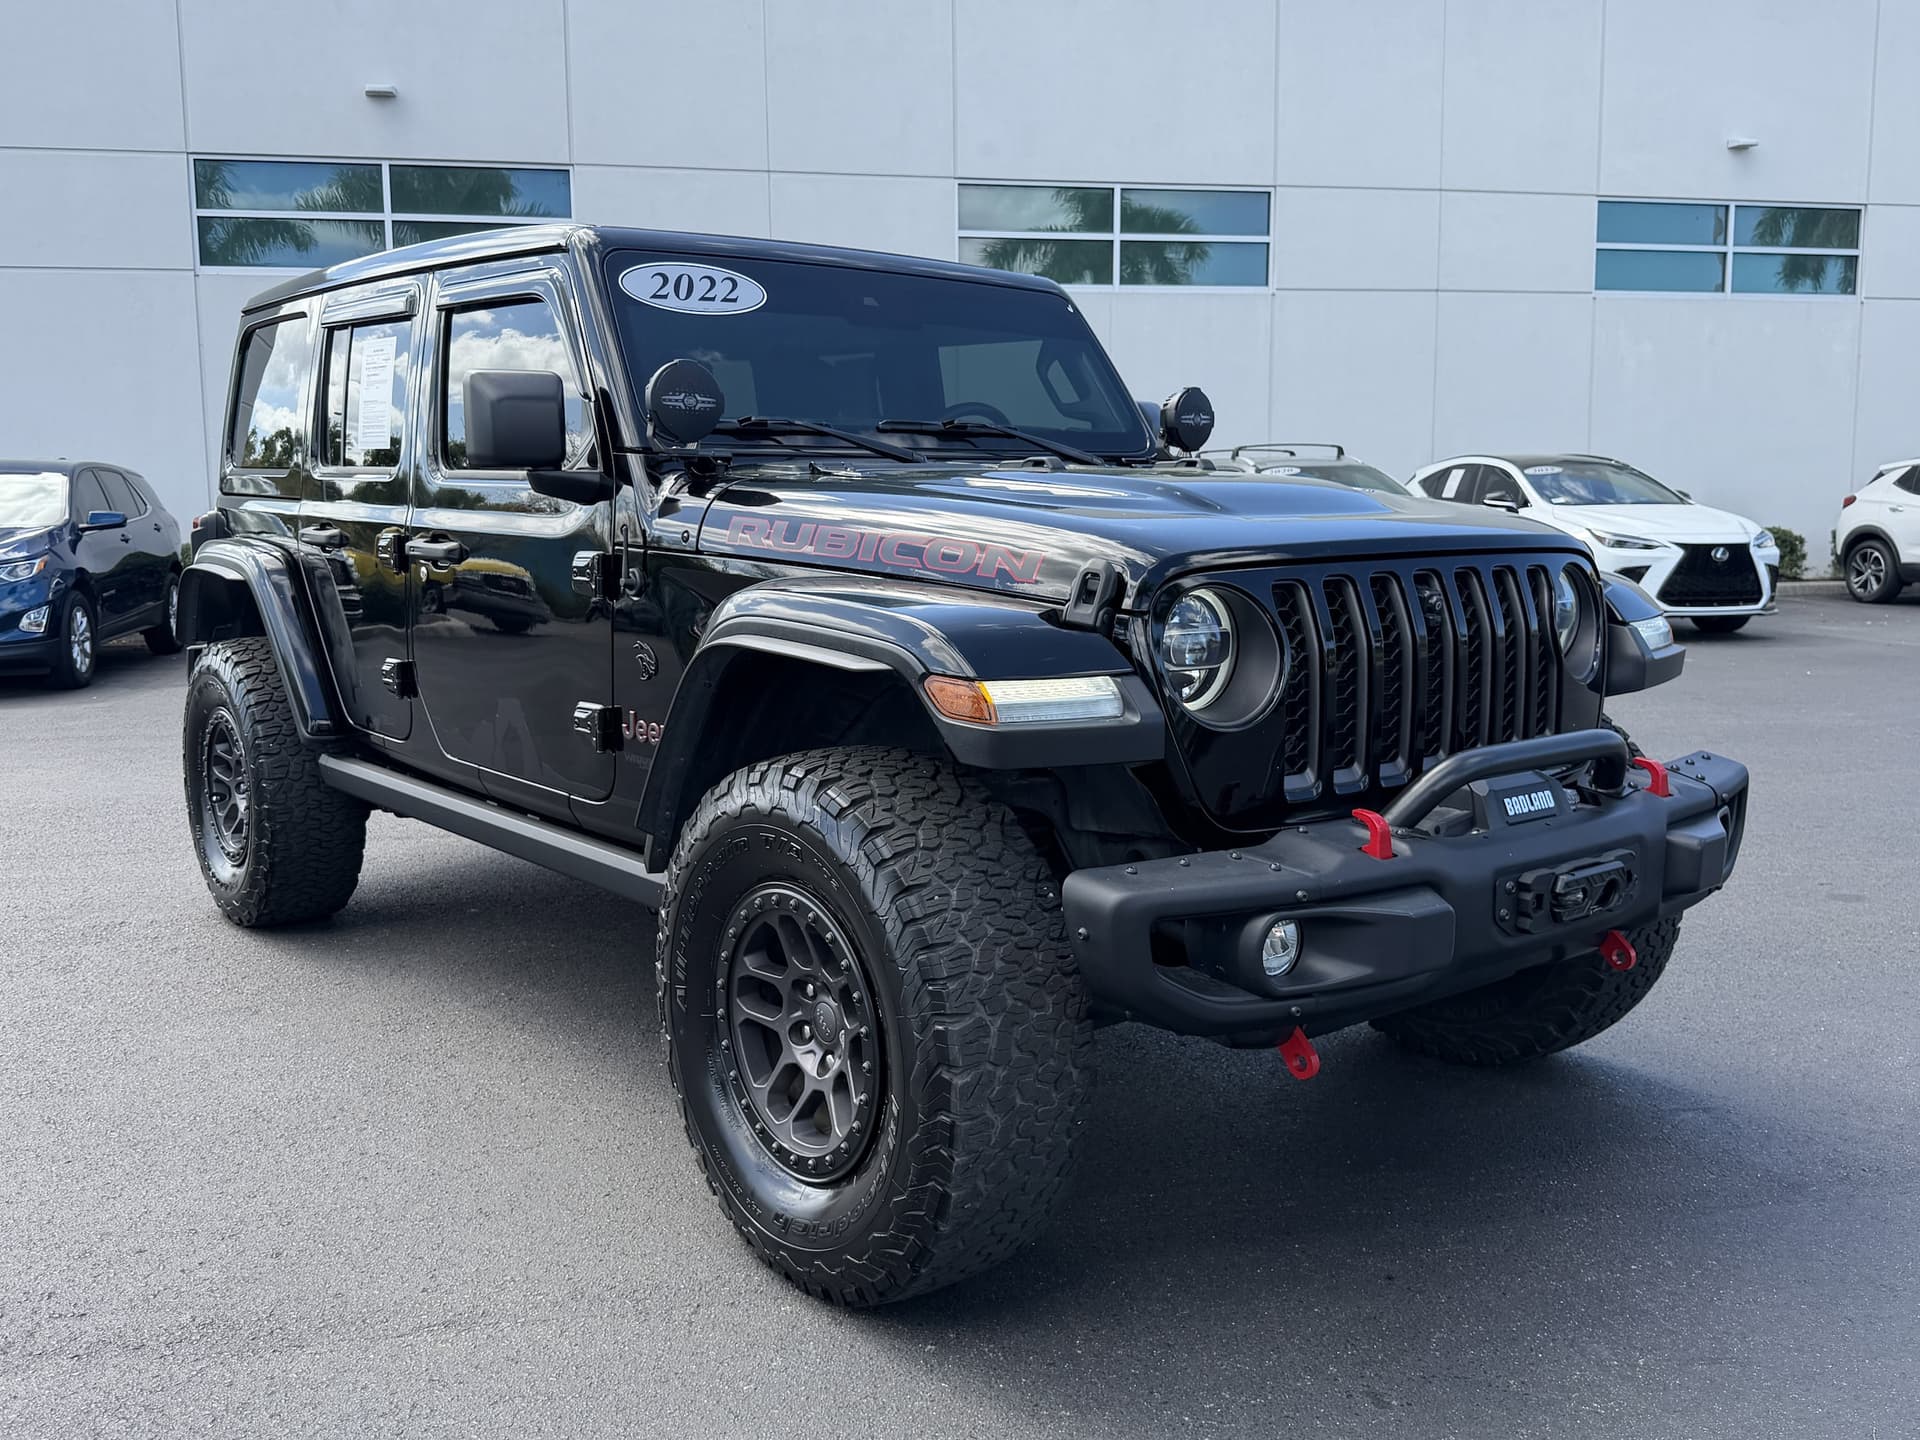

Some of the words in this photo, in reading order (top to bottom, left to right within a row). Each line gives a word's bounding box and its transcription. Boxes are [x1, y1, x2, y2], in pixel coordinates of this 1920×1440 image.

[649, 272, 740, 303] 2022
[725, 515, 1046, 584] RUBICON
[1503, 790, 1556, 817] BADLAND
